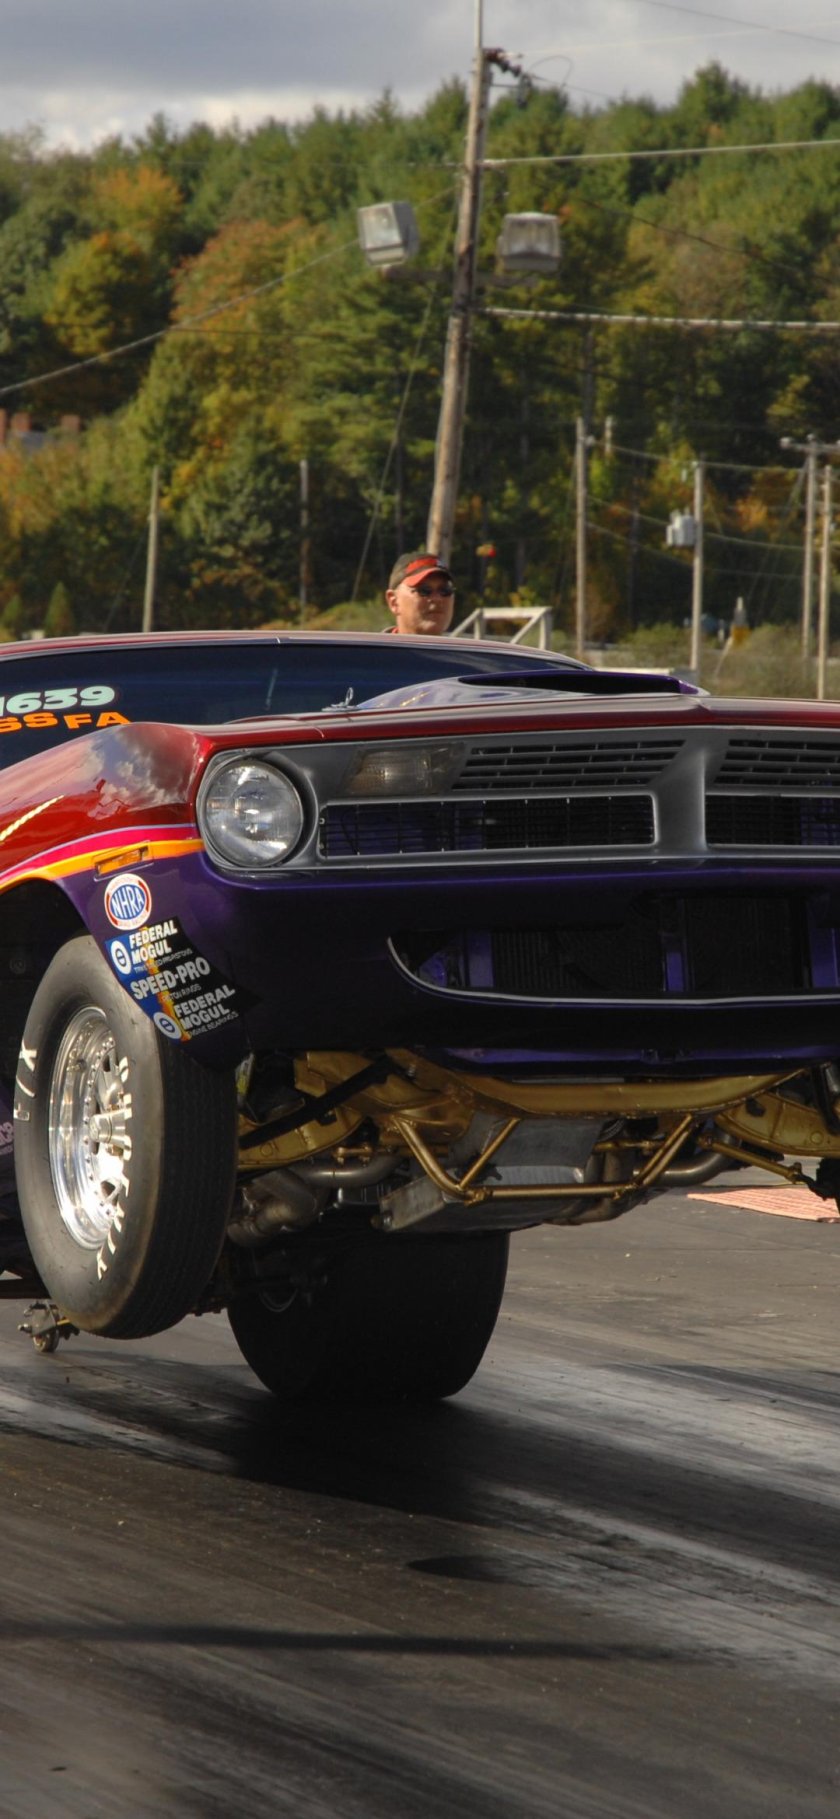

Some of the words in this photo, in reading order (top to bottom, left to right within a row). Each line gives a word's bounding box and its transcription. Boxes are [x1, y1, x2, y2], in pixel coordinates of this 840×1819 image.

[111, 886, 145, 919] NHRA
[129, 920, 178, 949] FEDERAL
[131, 939, 172, 965] MOGUL
[174, 985, 236, 1018] FEDERAL
[180, 1004, 230, 1030] MOGUL
